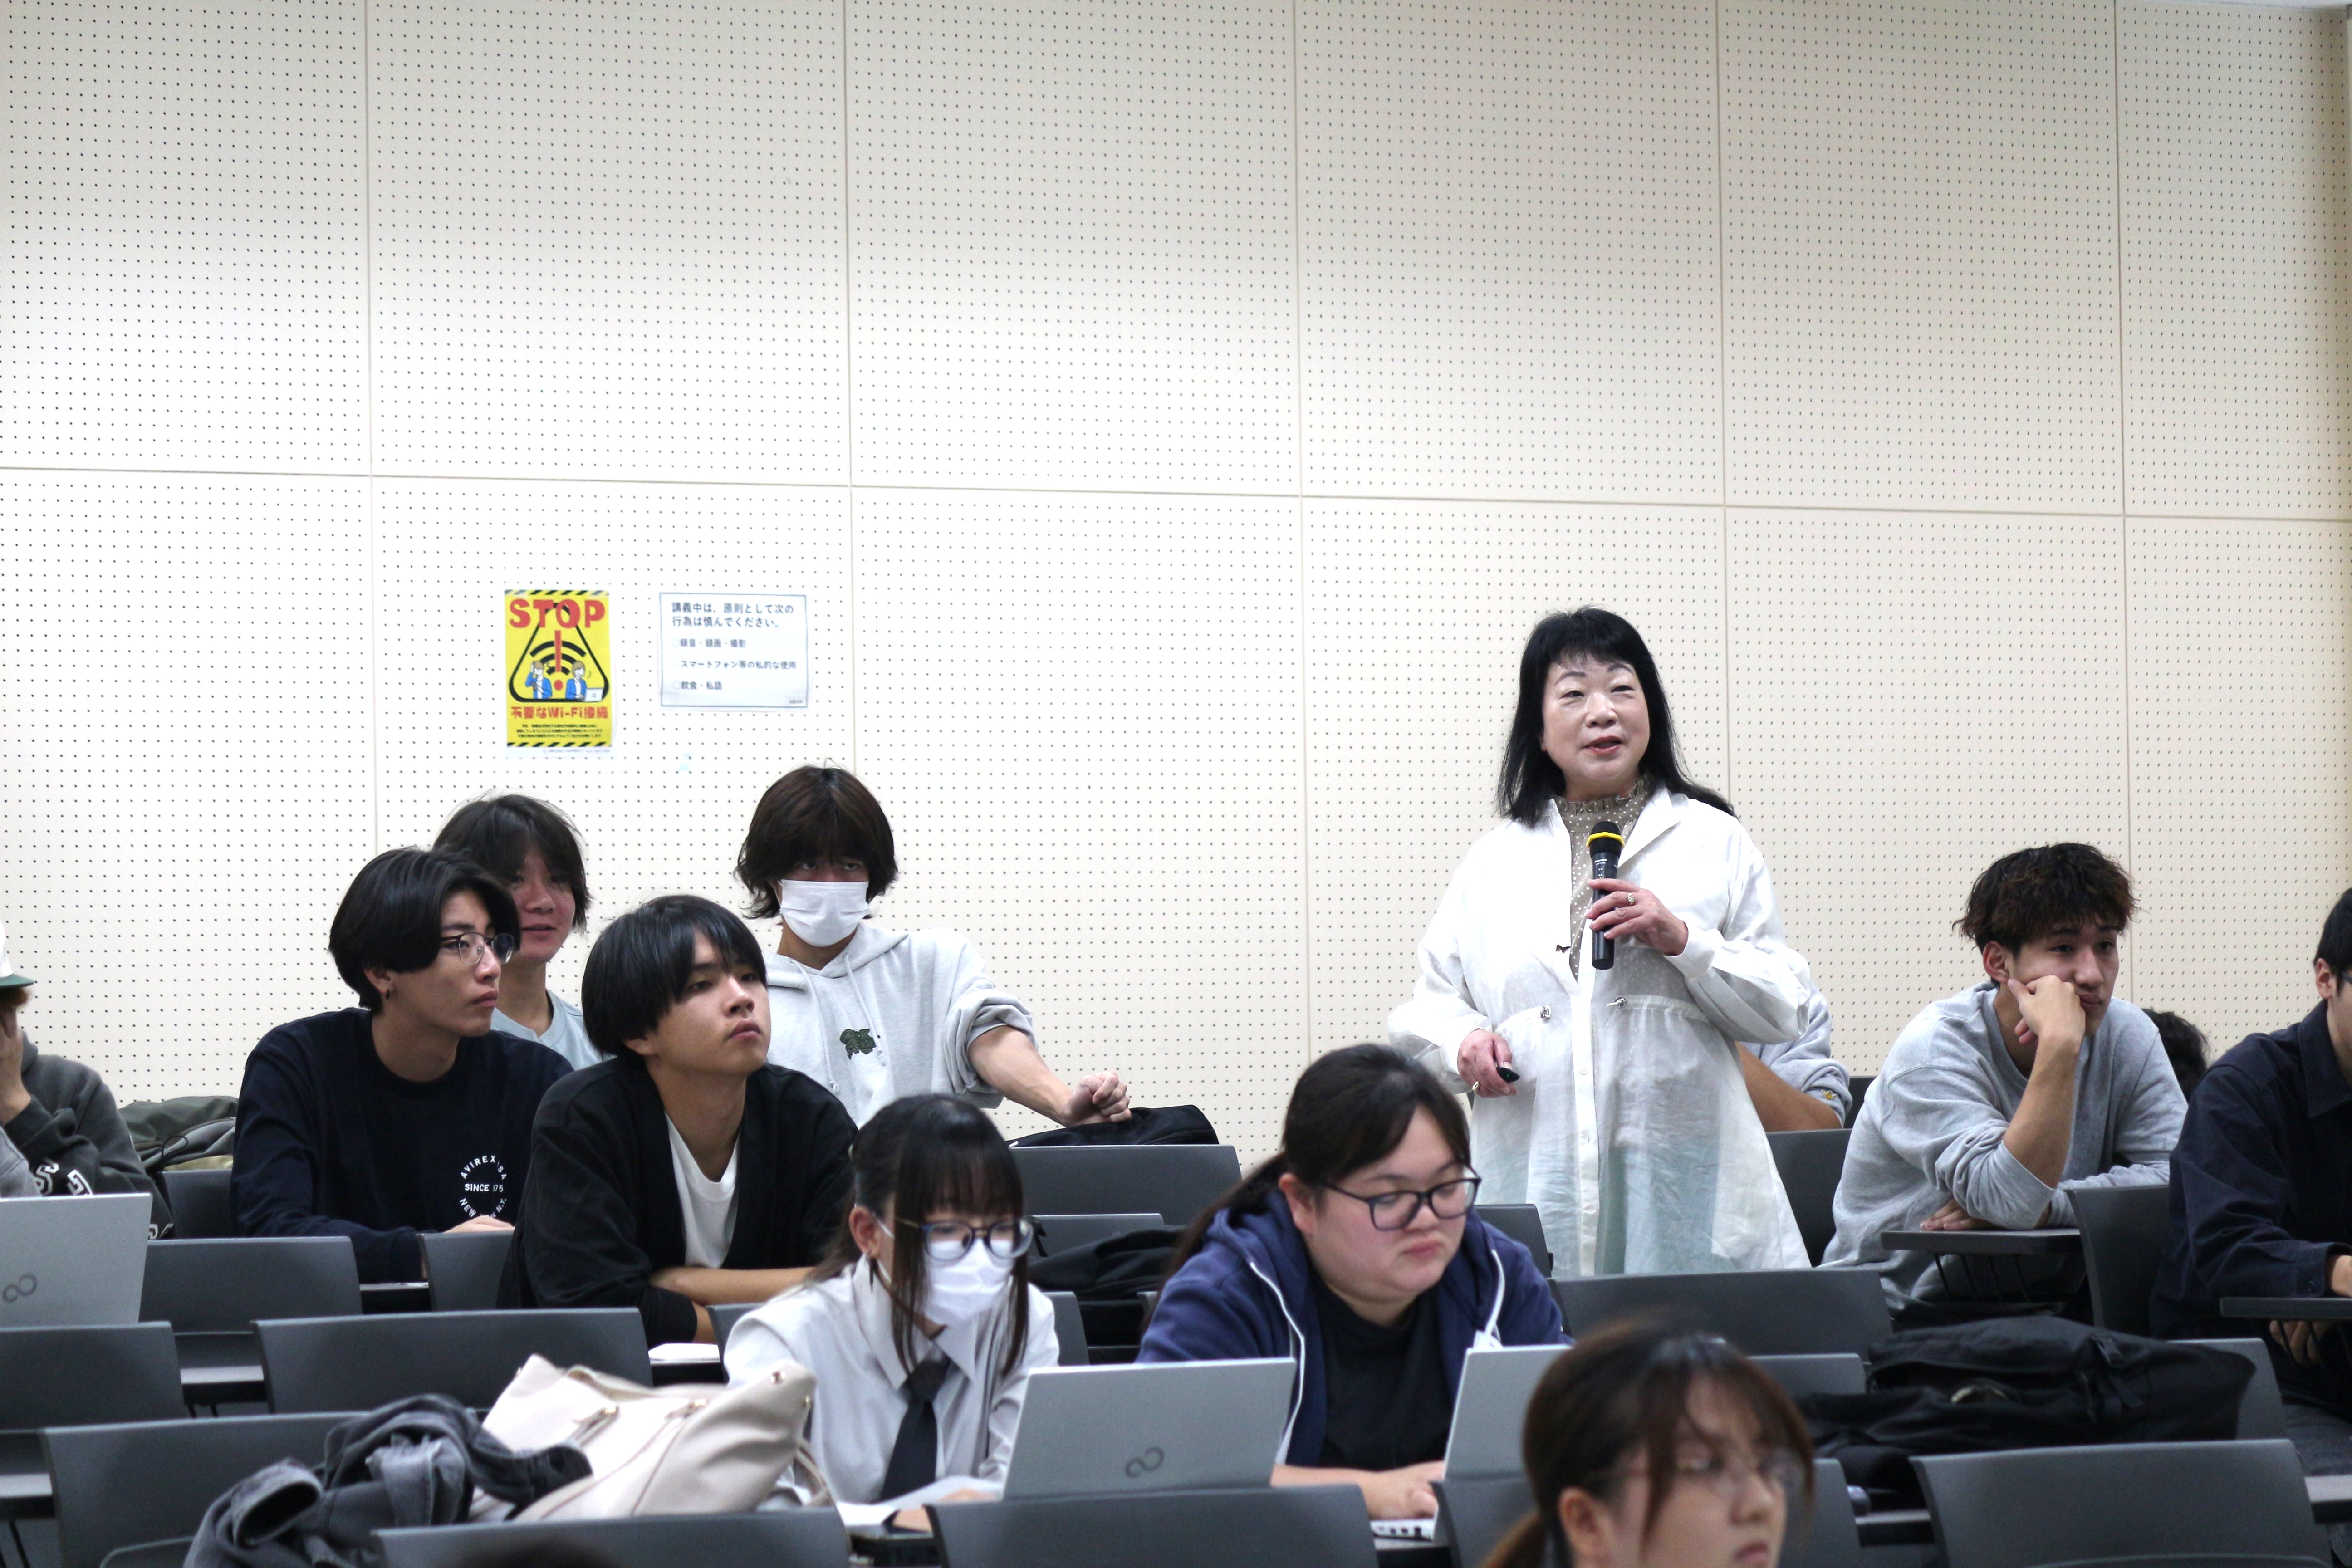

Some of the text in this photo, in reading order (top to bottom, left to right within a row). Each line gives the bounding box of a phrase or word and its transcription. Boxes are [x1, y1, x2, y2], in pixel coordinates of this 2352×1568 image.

[510, 599, 605, 628] STOP
[460, 1155, 507, 1180] AVIREX SA
[465, 1183, 490, 1192] SINCE
[459, 1198, 476, 1217] NEW
